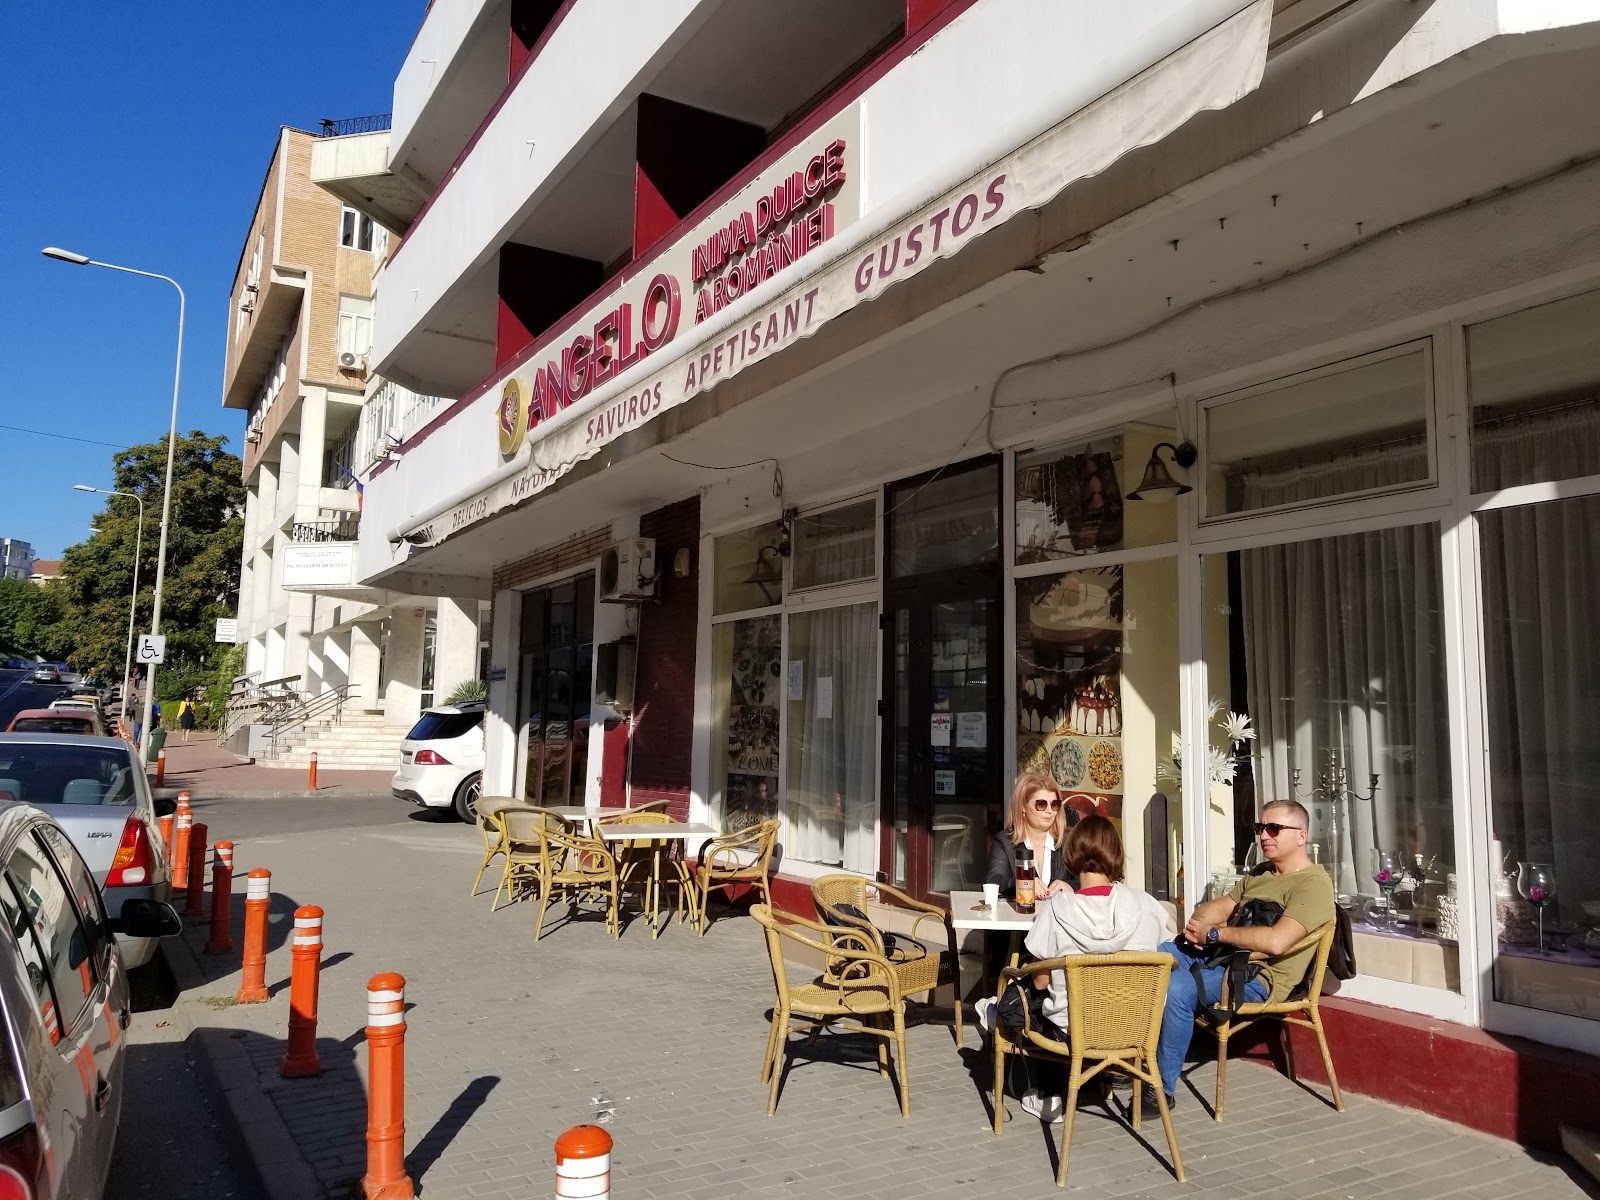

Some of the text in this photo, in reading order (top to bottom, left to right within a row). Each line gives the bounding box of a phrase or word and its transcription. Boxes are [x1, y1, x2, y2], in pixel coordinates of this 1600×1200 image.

[692, 138, 846, 283] INIMA DULCE
[695, 203, 835, 325] A ROMÂNIEI
[527, 273, 682, 432] ANGELO
[586, 174, 1006, 444] SAVUROS APETISANT GUSTOS
[453, 497, 488, 528] DELICIOS
[738, 753, 779, 771] LOVE
